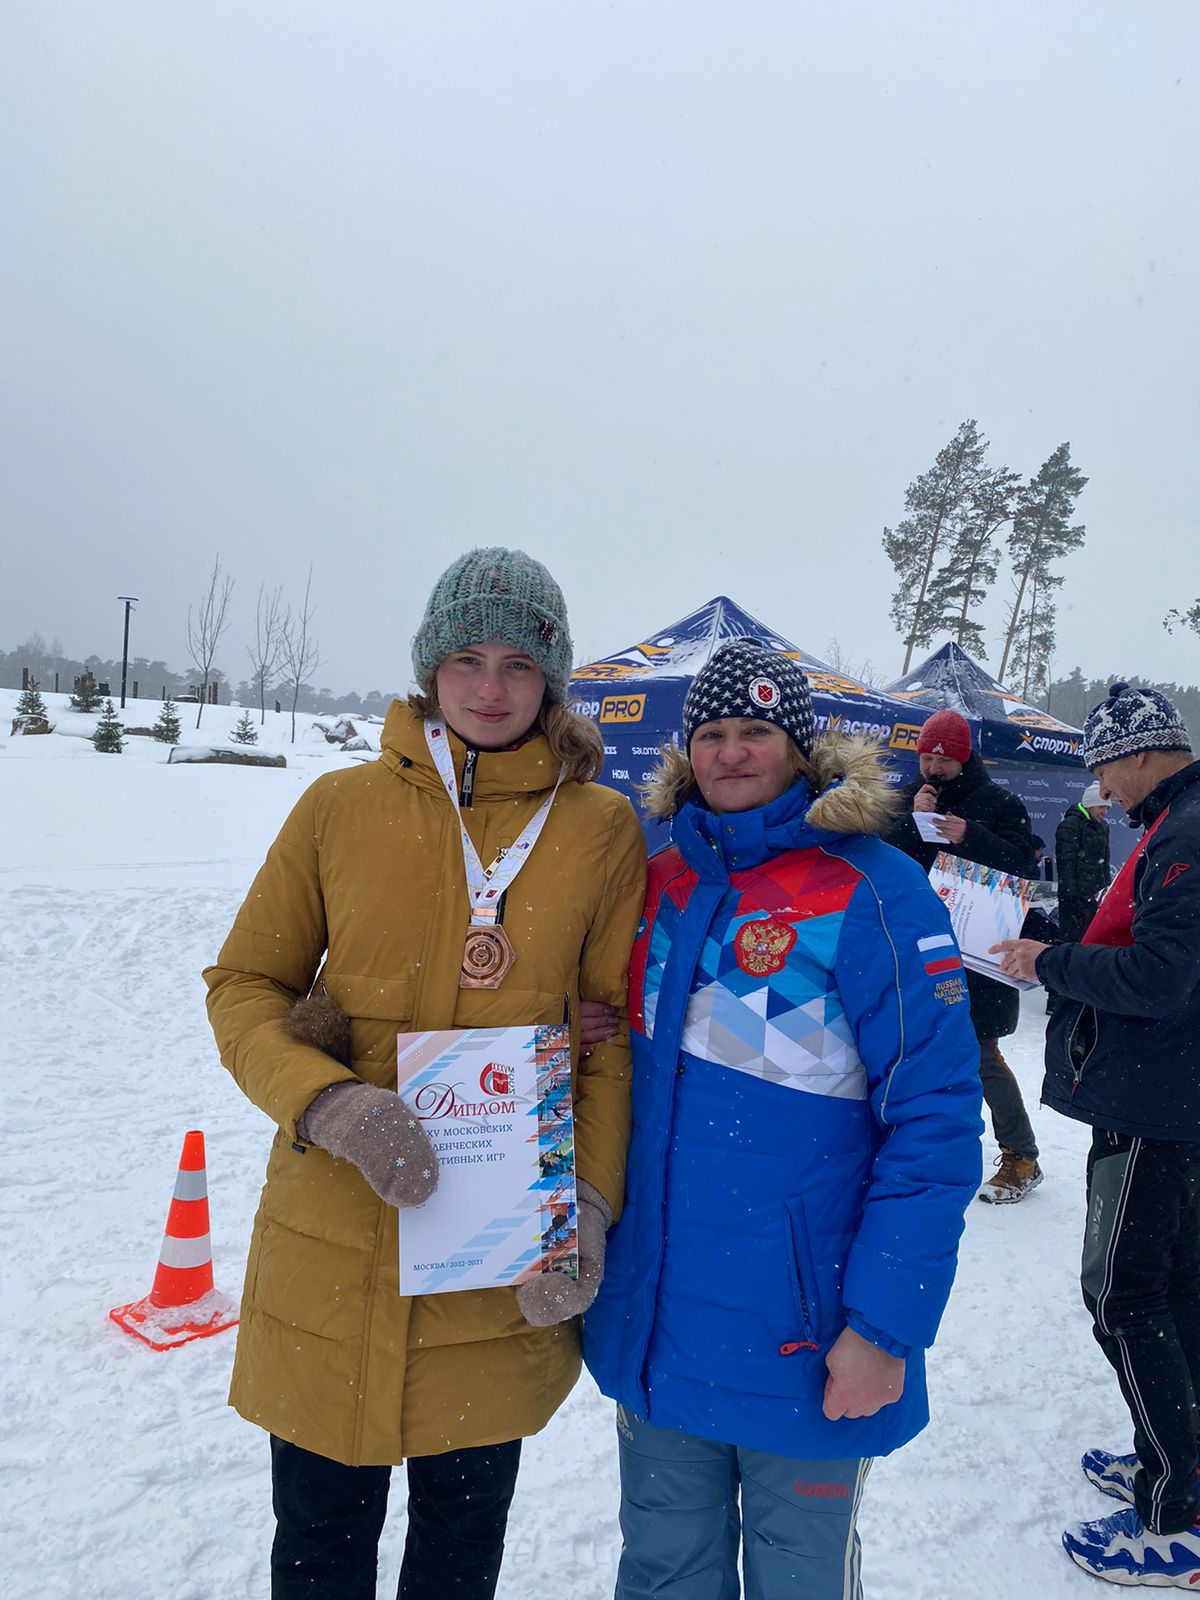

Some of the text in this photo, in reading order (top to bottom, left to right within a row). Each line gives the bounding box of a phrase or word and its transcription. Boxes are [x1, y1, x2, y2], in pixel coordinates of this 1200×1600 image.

[603, 699, 641, 719] PRO
[893, 727, 921, 746] PR
[936, 977, 963, 990] RUSSIAN
[934, 985, 968, 1000] NATIONAL
[944, 993, 966, 1006] TEAM
[443, 1124, 513, 1137] МОСКОВСКИХ
[433, 1139, 493, 1153] ДЕНЧЕСКИХ
[438, 1153, 506, 1166] ТИВНЫХ ИГР
[413, 1262, 446, 1271] МОСКВА
[450, 1259, 483, 1268] 2022-2023
